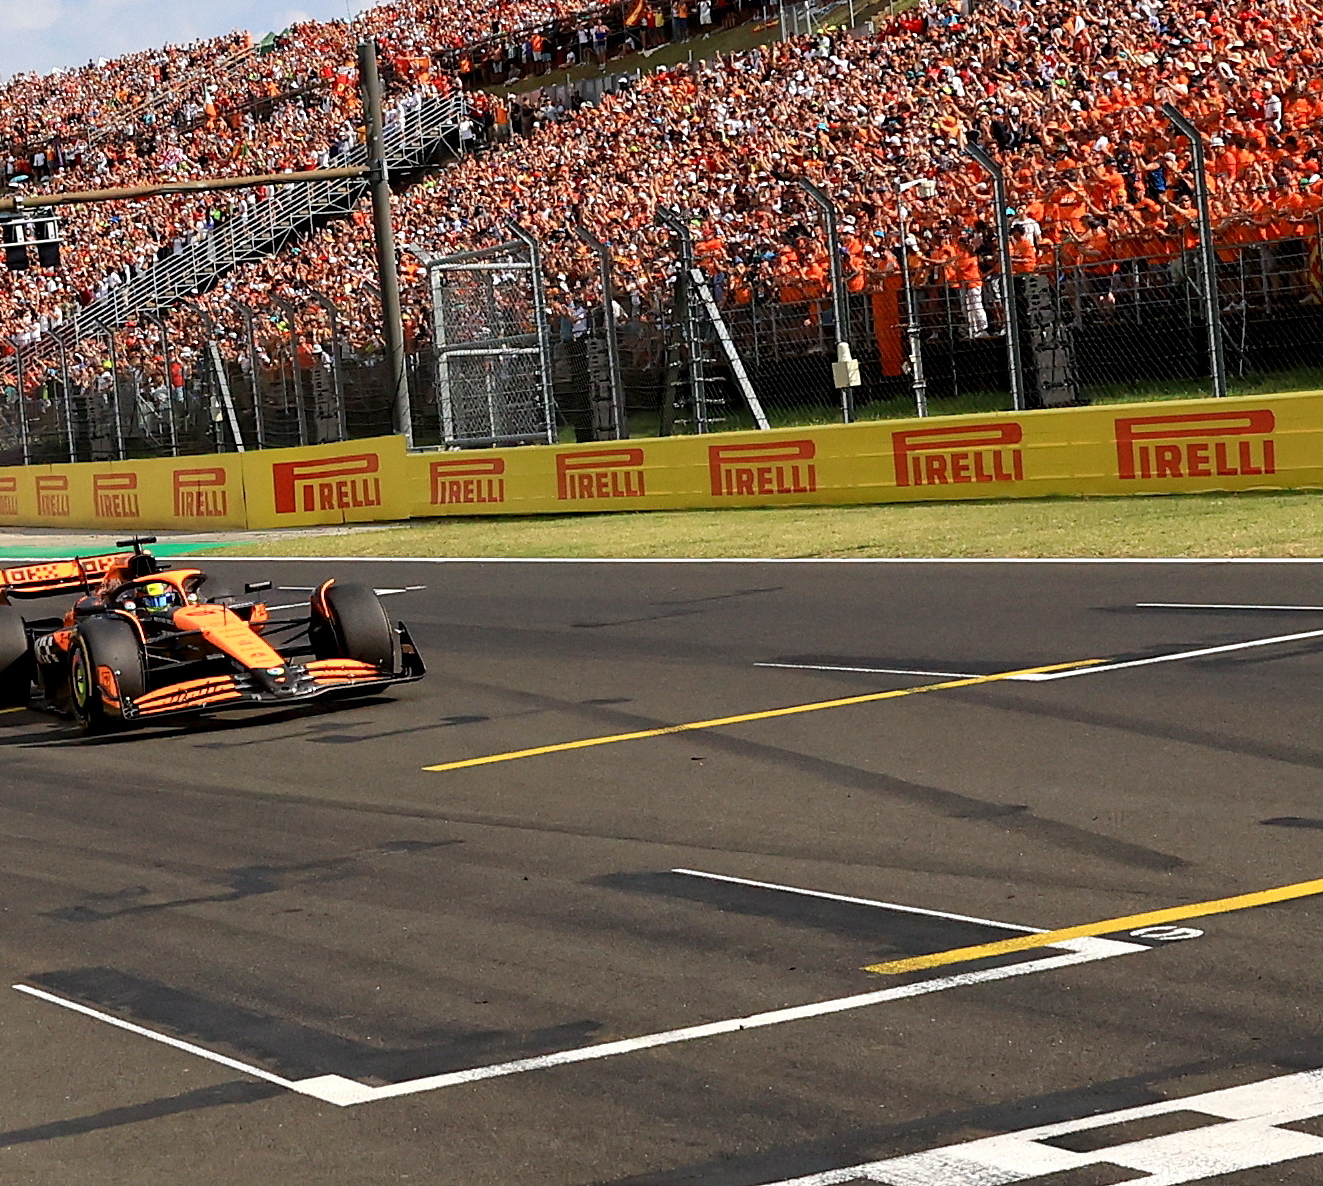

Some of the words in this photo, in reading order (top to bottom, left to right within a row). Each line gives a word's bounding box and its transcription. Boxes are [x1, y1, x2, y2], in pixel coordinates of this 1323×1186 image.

[709, 439, 816, 496] PIRELLI
[892, 422, 1024, 487] PIRELLI
[1115, 409, 1275, 480] PIRELLI
[35, 475, 69, 516] PIRELLI
[93, 472, 139, 518] PIRELLI
[173, 467, 227, 517] PIRELLI
[273, 452, 381, 514] PIRELLI
[430, 457, 504, 504] PIRELLI
[556, 448, 645, 500] PIRELLI
